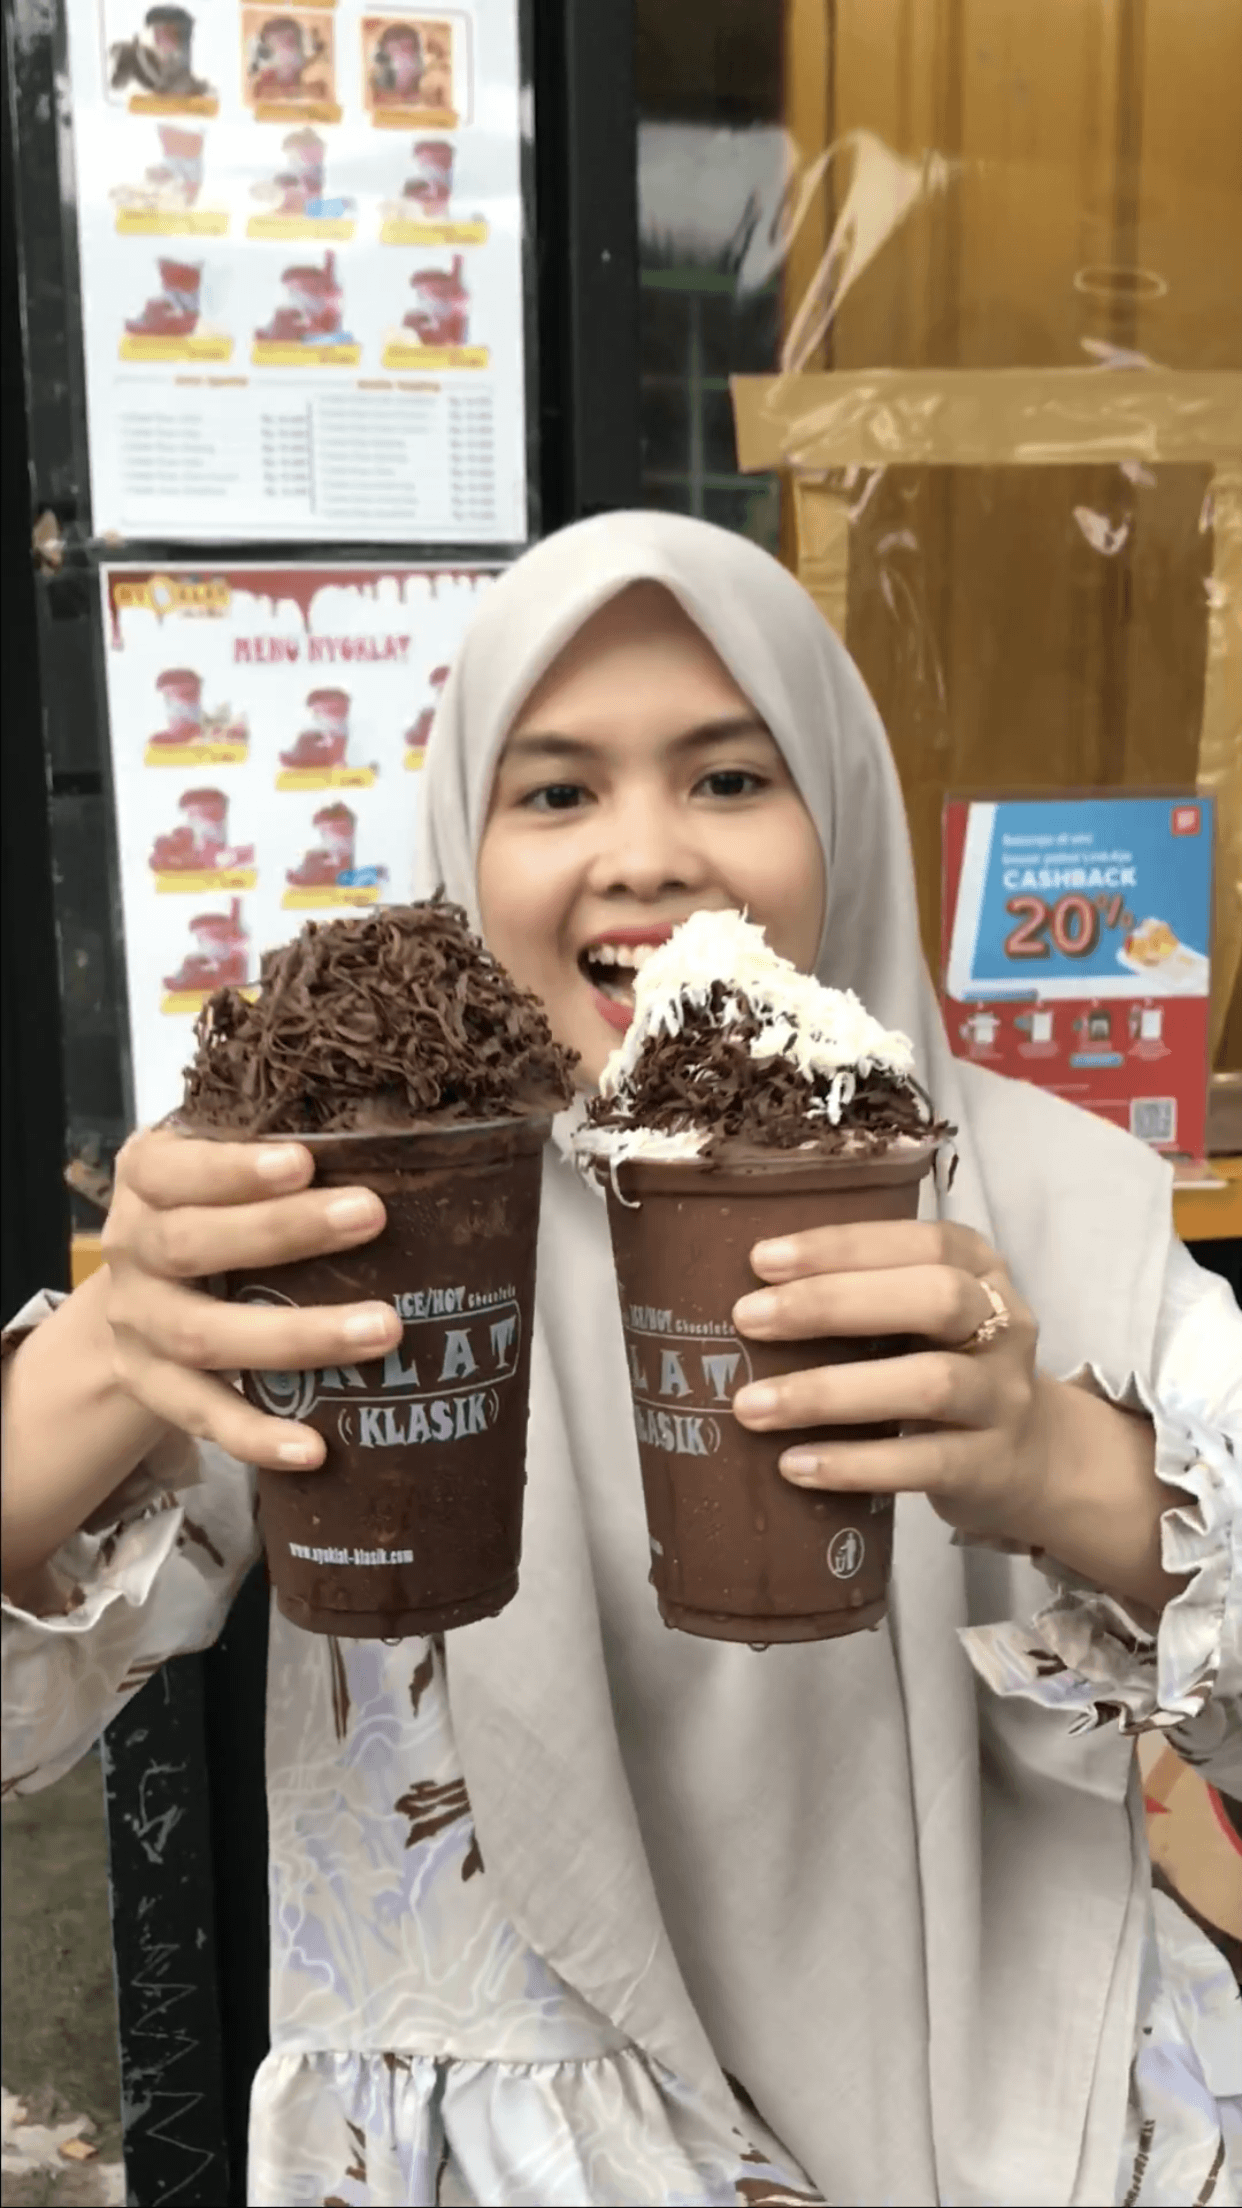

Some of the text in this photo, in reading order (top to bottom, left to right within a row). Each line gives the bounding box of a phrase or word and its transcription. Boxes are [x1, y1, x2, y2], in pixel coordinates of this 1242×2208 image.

[1003, 867, 1137, 889] CASHBACK
[1004, 894, 1134, 959] 20%
[358, 1393, 488, 1448] KLASIK
[635, 1405, 711, 1457] LASIK
